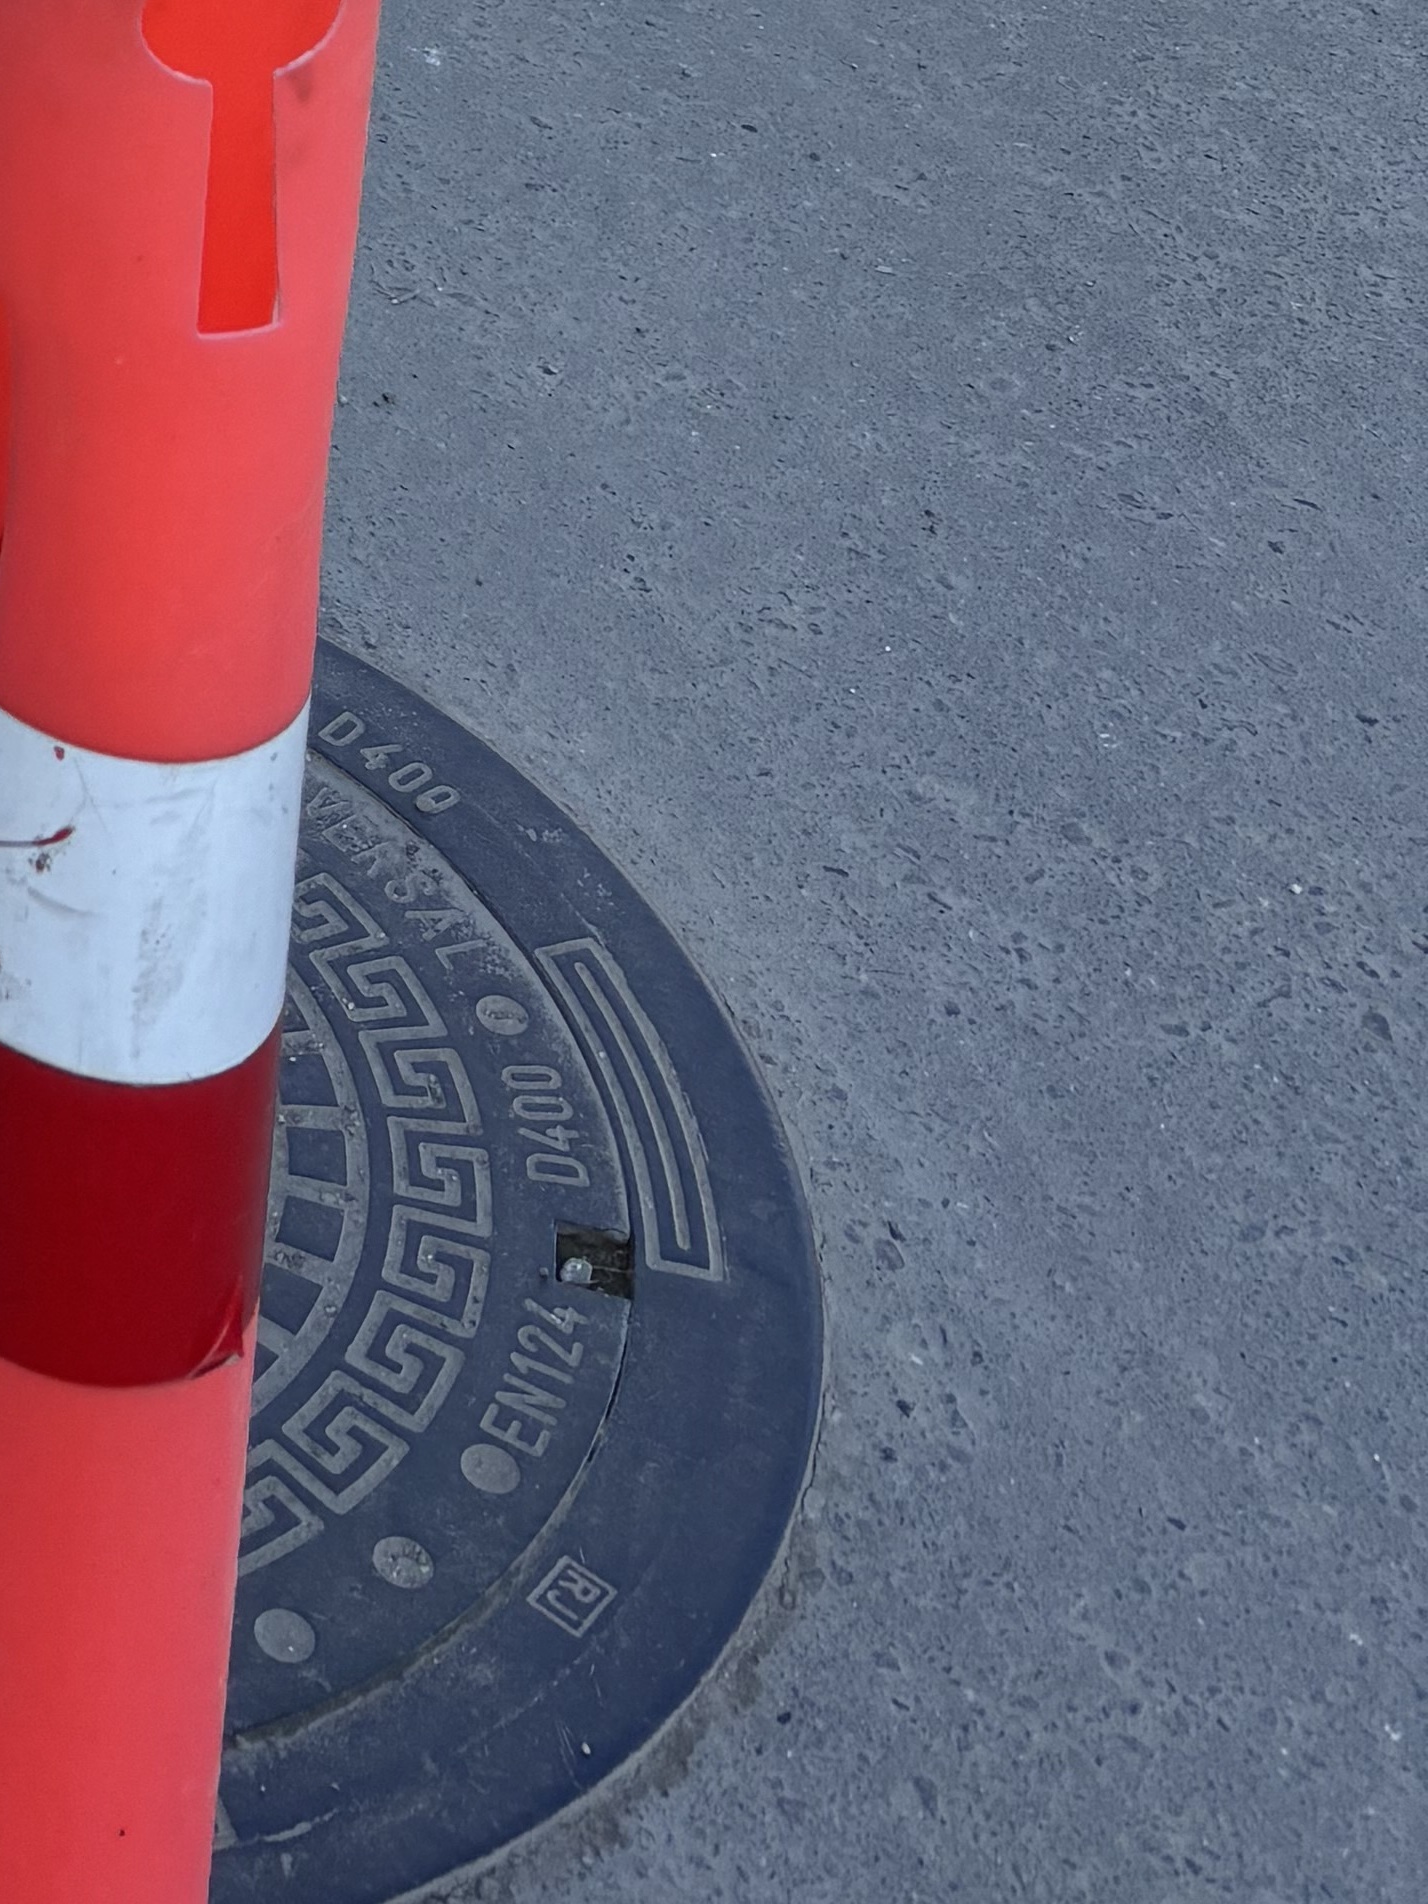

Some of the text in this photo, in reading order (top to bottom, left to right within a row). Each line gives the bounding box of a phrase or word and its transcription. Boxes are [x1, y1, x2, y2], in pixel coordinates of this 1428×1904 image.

[305, 786, 494, 972] VERSAL
[500, 1064, 591, 1189] D400
[479, 1297, 590, 1458] EN124
